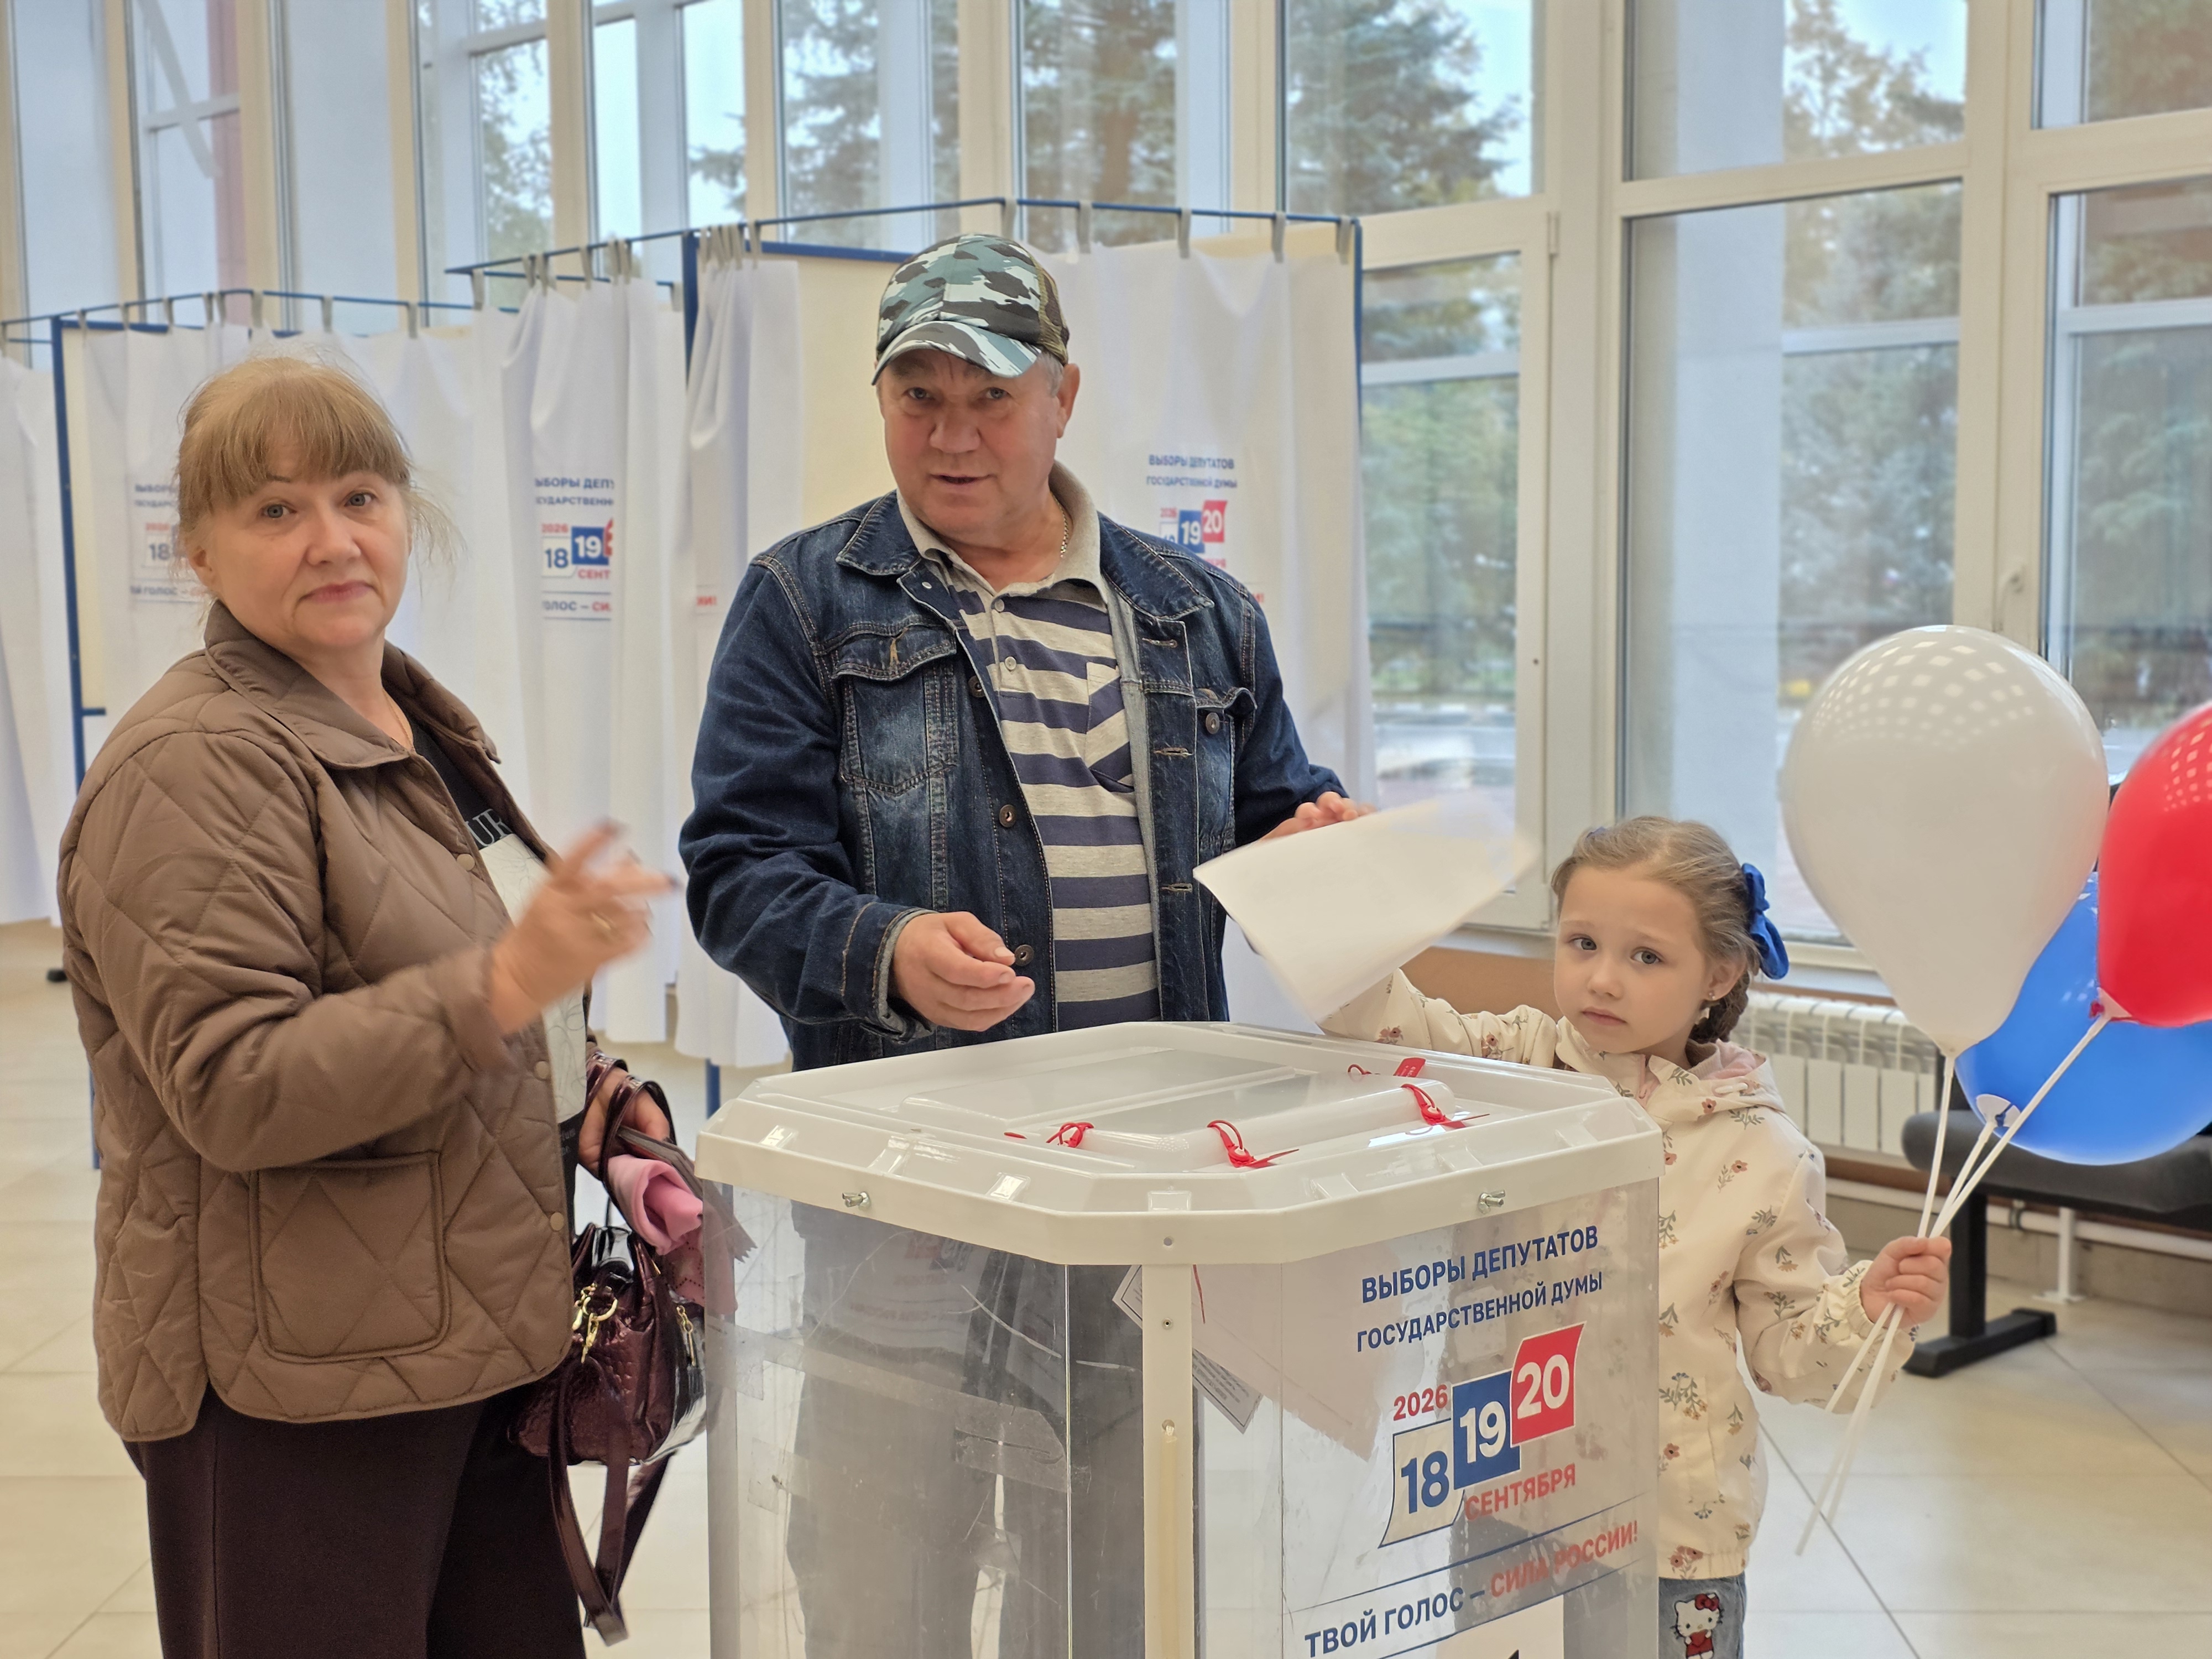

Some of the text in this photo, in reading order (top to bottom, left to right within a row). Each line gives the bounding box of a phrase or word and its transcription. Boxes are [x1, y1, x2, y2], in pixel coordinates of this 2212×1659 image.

[1149, 455, 1187, 466] ВЫБОРЫ
[1181, 510, 1223, 545] 19 20
[149, 543, 170, 560] 18
[545, 547, 568, 568] 18
[575, 535, 602, 558] 19
[1362, 1225, 1598, 1303] ВЫБОРЫ ДЕПУТАТОВ
[1357, 1271, 1603, 1353] ГОСУДАРСТВЕННОЙ ДУМЫ
[1393, 1384, 1448, 1421] 2026
[1401, 1354, 1570, 1515] 18 19 20
[1464, 1463, 1576, 1521] СЕНТЯБРЯ
[1304, 1610, 1377, 1659] ТВОЙ
[1384, 1587, 1464, 1635] ГОЛОС
[1490, 1557, 1549, 1598] СИЛА
[1554, 1519, 1639, 1574] РОССИИ!
